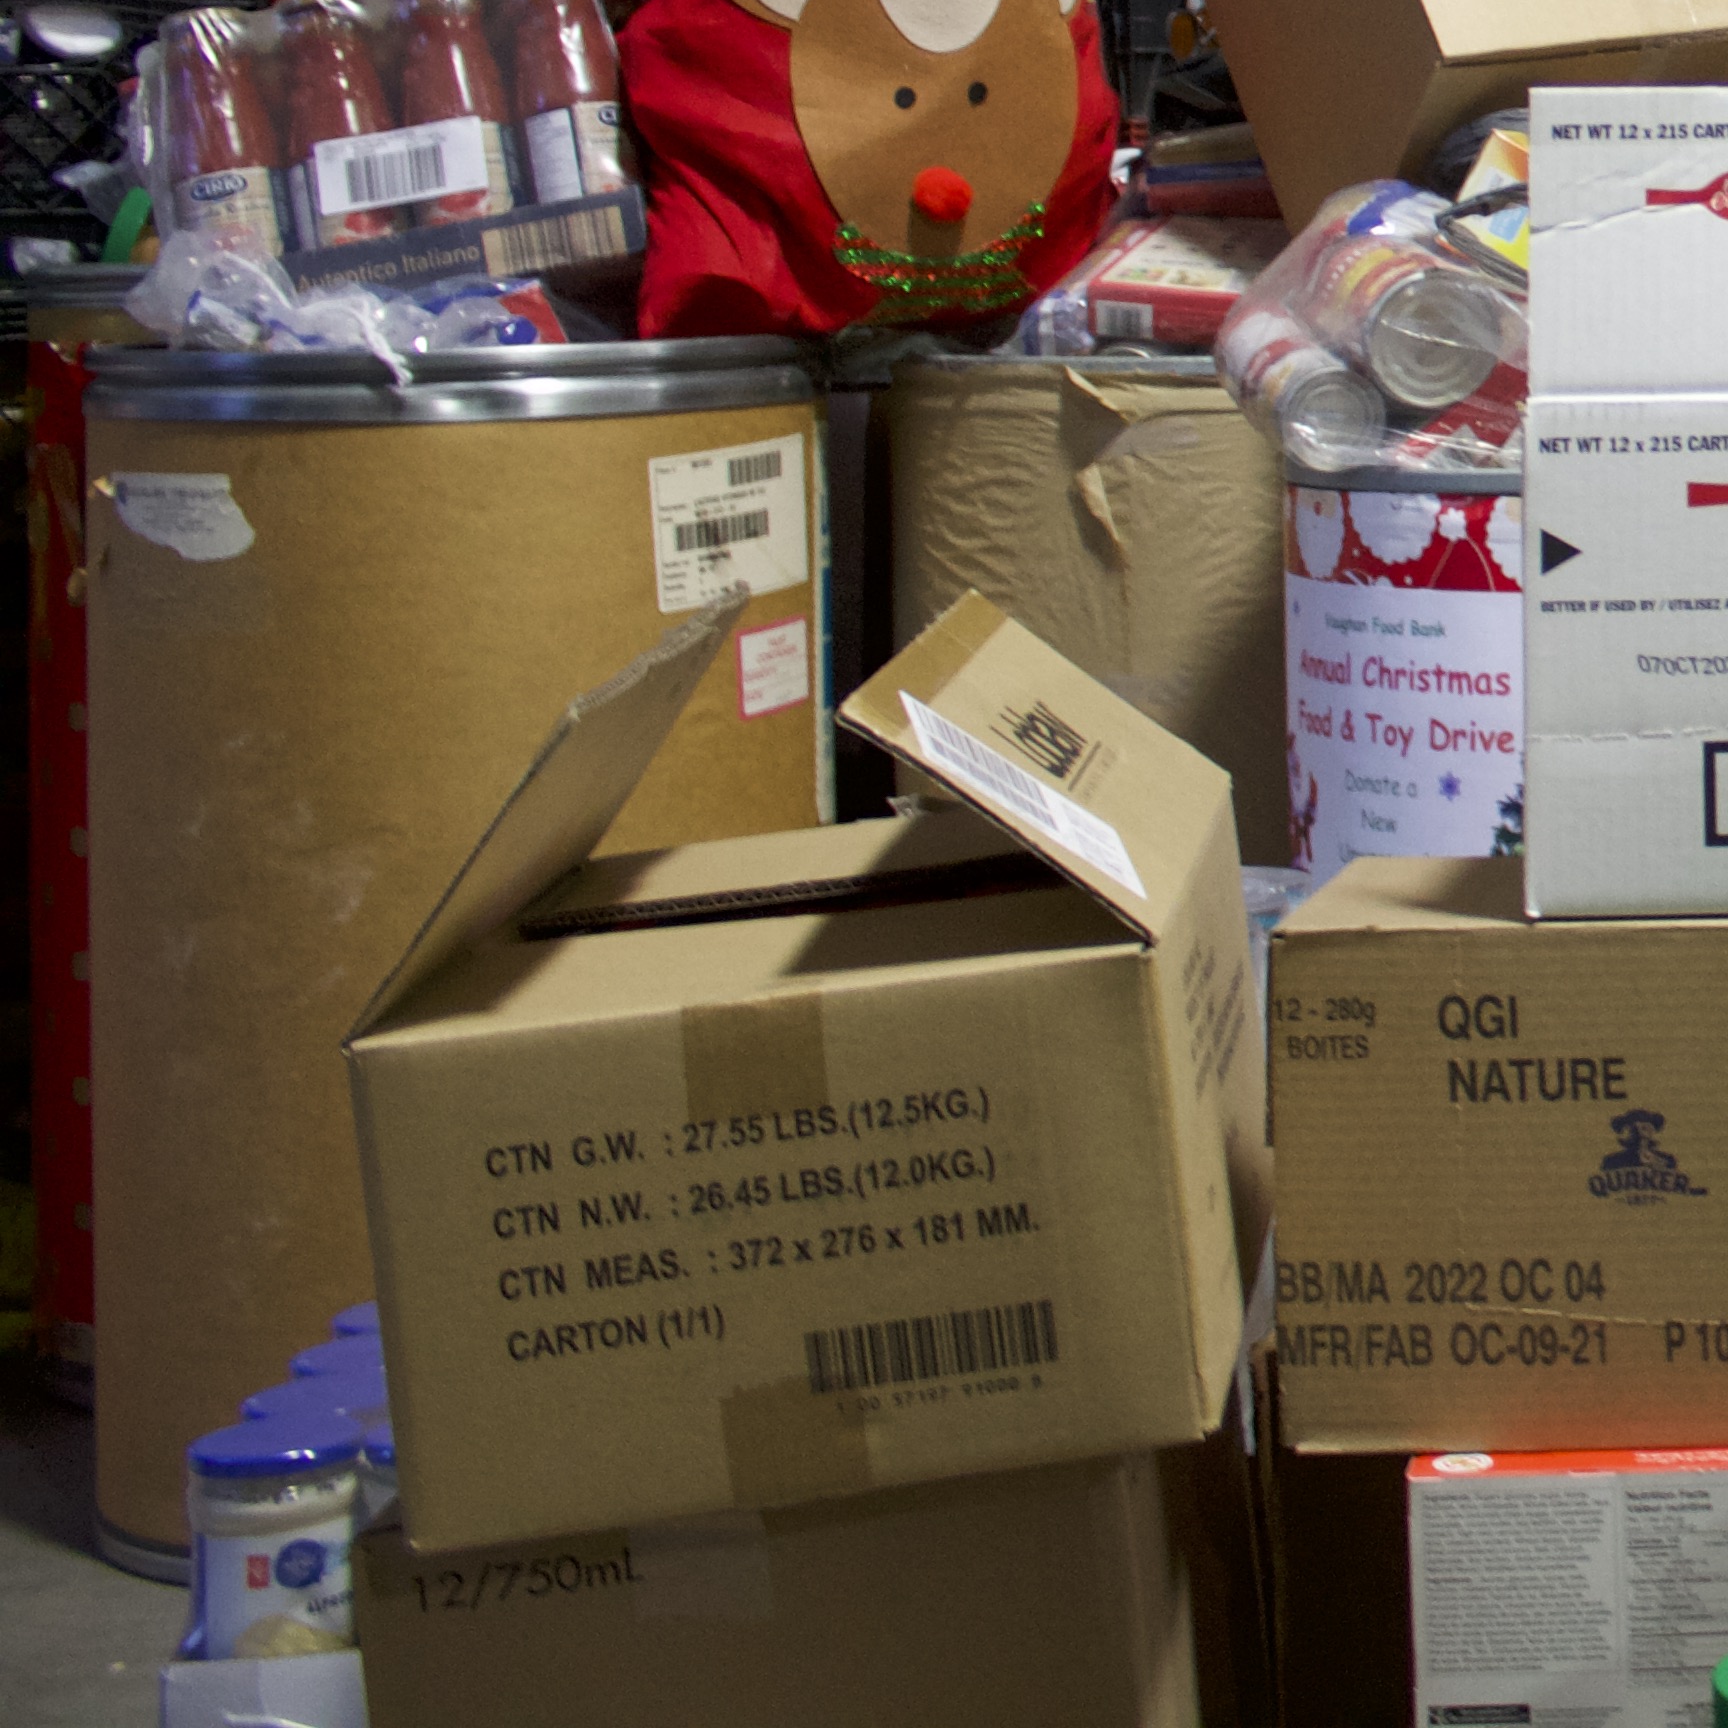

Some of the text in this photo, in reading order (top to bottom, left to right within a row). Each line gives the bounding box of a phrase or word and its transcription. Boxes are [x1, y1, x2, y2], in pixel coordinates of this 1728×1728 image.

[1552, 123, 1582, 141] NET
[1588, 123, 1613, 140] WT
[1619, 123, 1640, 140] 12
[1657, 123, 1689, 140] 215
[1362, 655, 1512, 698] Christmas
[1340, 709, 1355, 743] &
[1366, 712, 1414, 758] Toy
[1429, 718, 1516, 755] Drive
[1437, 995, 1519, 1040] QGI
[1448, 1057, 1627, 1103] NATURE
[485, 1140, 552, 1177] CTN
[683, 1115, 765, 1154] 27.55
[493, 1202, 561, 1239] CTN
[689, 1176, 772, 1216] 26.45
[500, 1263, 567, 1301] CTN
[584, 1249, 690, 1292] MEAS.
[729, 1237, 785, 1272] 372
[823, 1225, 877, 1259] 276
[913, 1214, 967, 1247] 181
[1405, 1258, 1606, 1305] 2022 OC 04
[508, 1314, 648, 1363] CARTON
